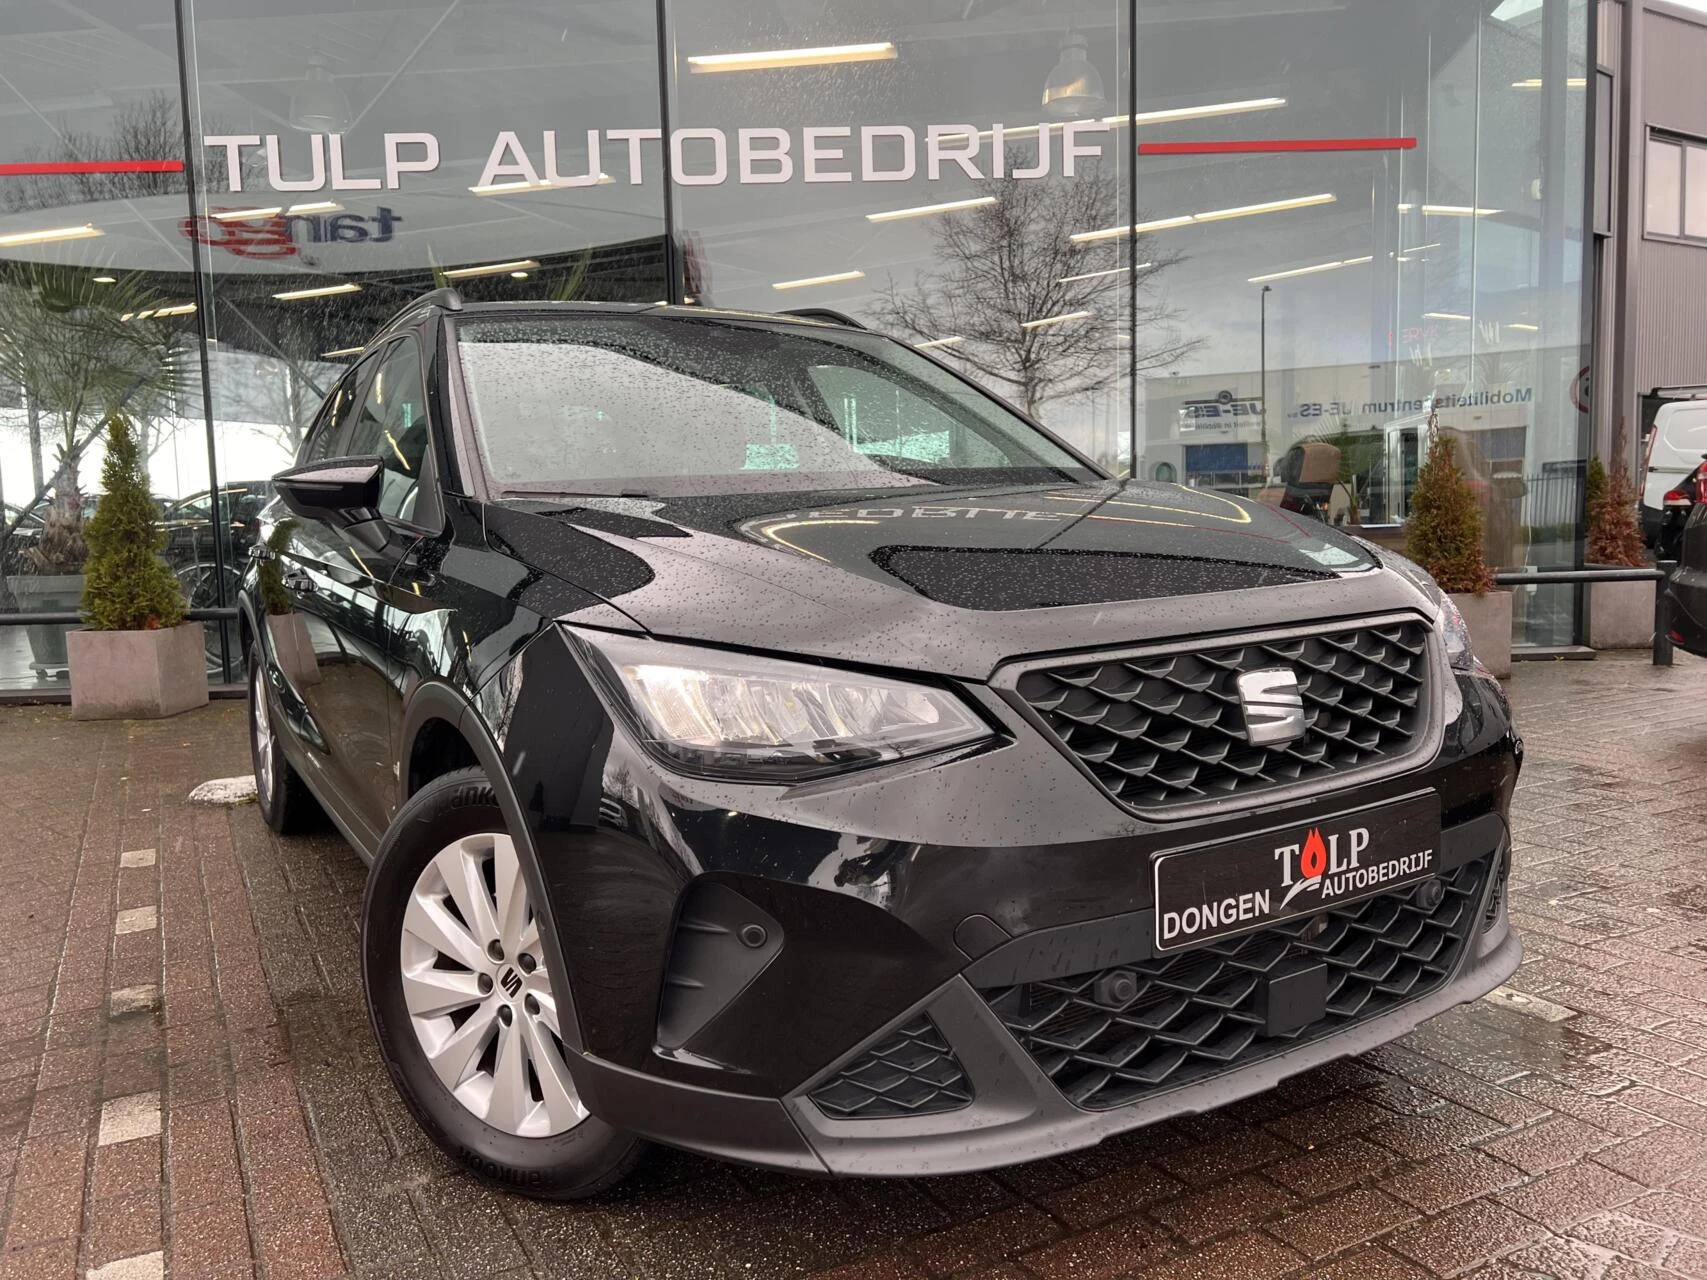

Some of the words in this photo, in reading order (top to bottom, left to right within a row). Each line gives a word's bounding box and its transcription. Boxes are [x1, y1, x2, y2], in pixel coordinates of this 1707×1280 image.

[203, 132, 441, 192] TULP
[477, 122, 1110, 186] AUTOBEDRIJF
[1163, 889, 1270, 939] DONGEN
[1321, 849, 1433, 899] AUTOBEDRIJF
